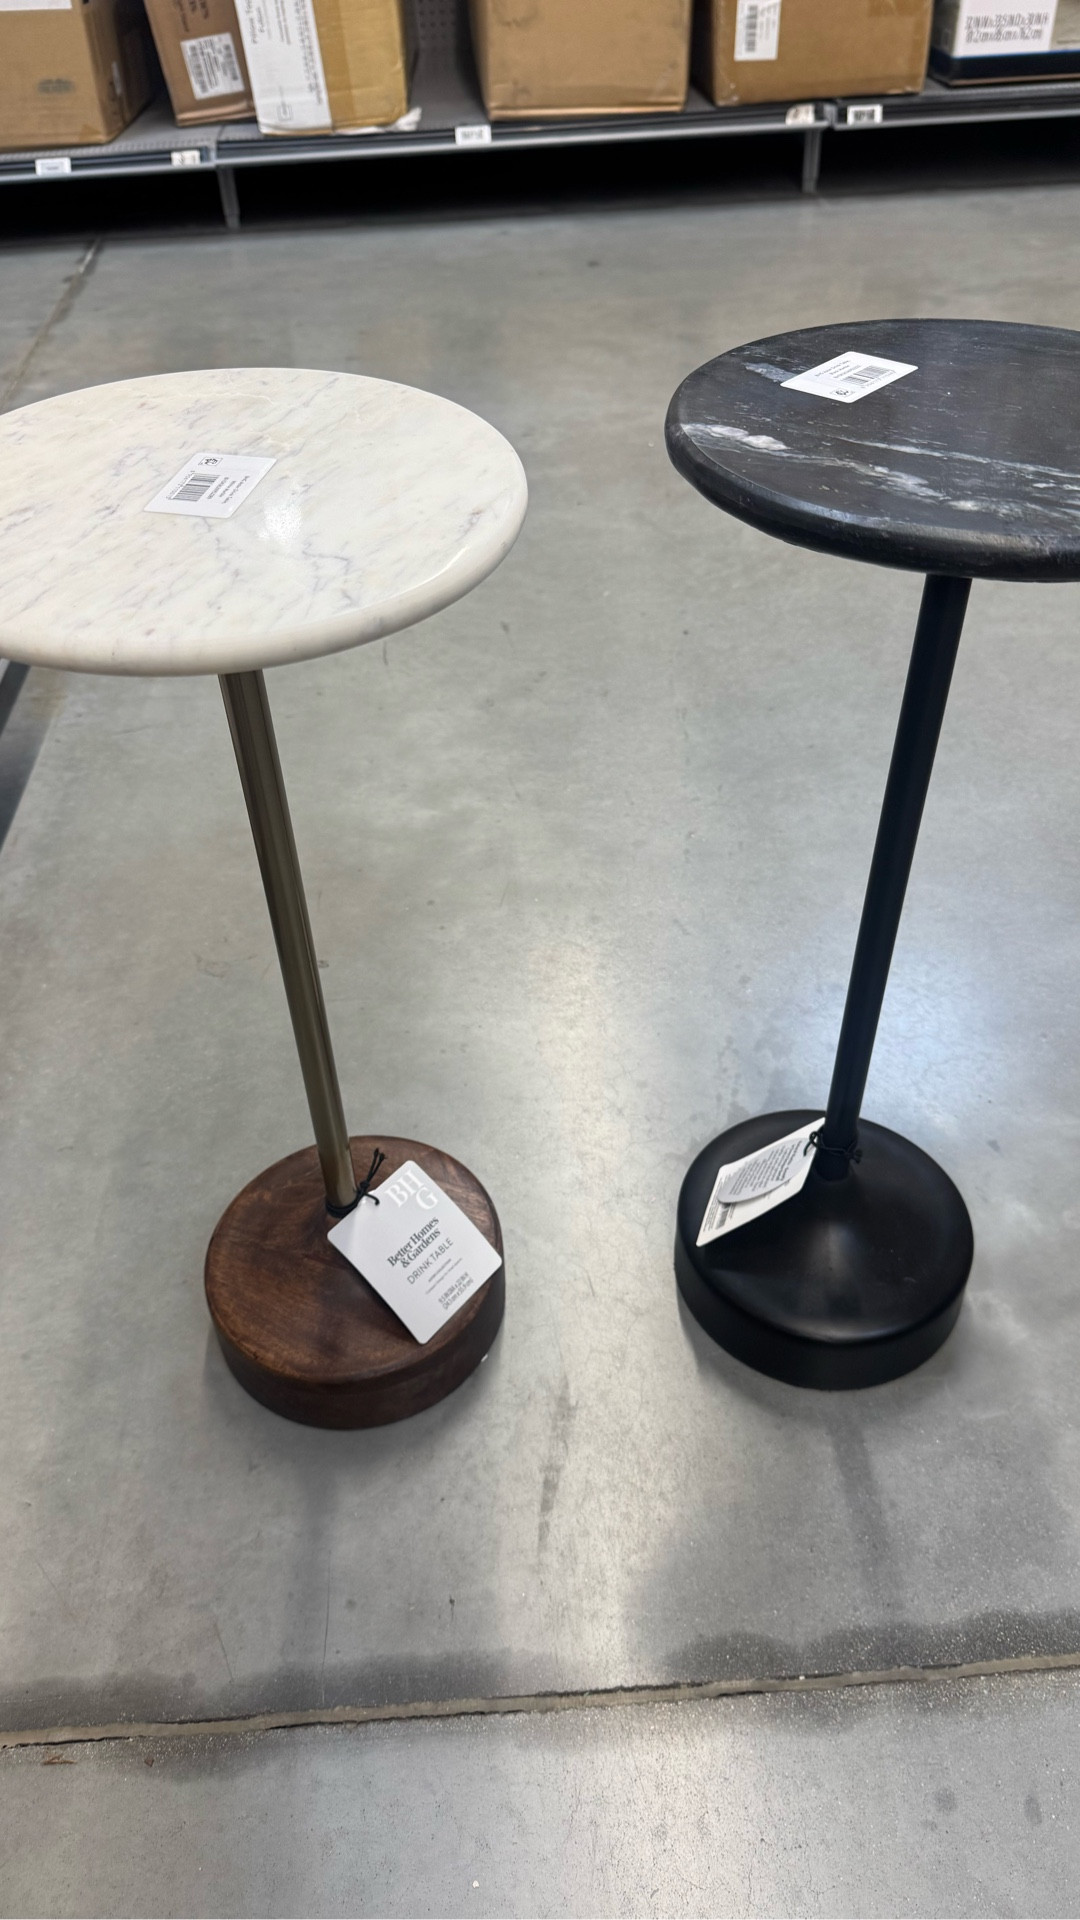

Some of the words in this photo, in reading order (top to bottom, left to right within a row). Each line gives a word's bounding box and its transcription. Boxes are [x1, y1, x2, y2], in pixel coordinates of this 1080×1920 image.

[386, 1240, 413, 1268] Better
[410, 1216, 440, 1245] Homes
[407, 1228, 441, 1262] Gardens
[407, 1258, 433, 1285] DRINK
[430, 1237, 454, 1264] TABLE
